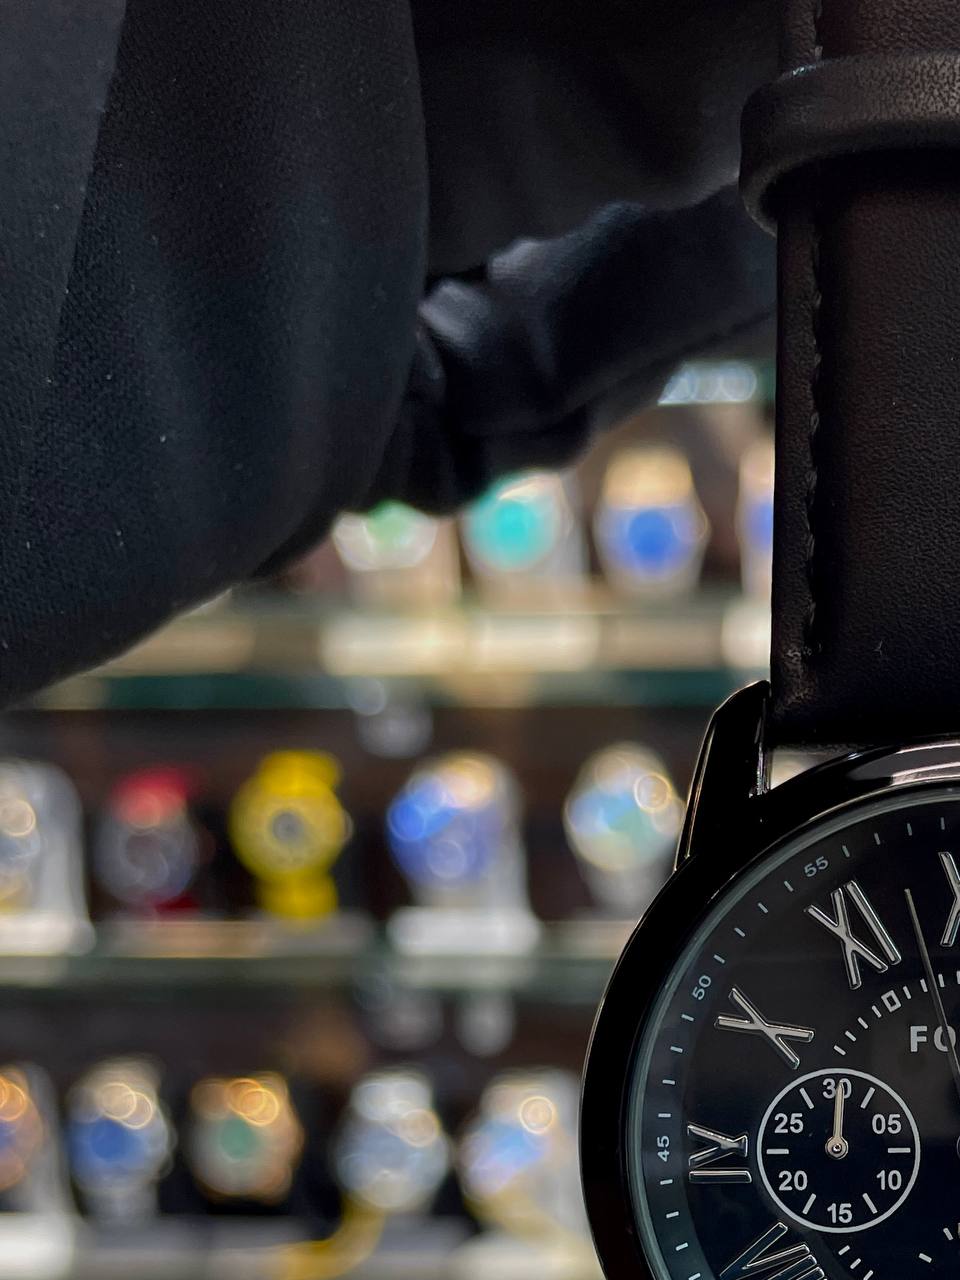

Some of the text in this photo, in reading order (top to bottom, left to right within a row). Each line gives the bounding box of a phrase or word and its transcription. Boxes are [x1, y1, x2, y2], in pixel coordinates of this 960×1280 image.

[804, 856, 829, 878] 55
[804, 880, 902, 990] XI
[692, 975, 712, 1001] 50
[714, 984, 815, 1070] X
[822, 1078, 852, 1099] 30
[774, 1113, 804, 1134] 25
[872, 1114, 902, 1135] 05
[657, 1135, 670, 1162] 45
[778, 1170, 808, 1191] 20
[876, 1170, 902, 1190] 10
[827, 1203, 853, 1224] 15
